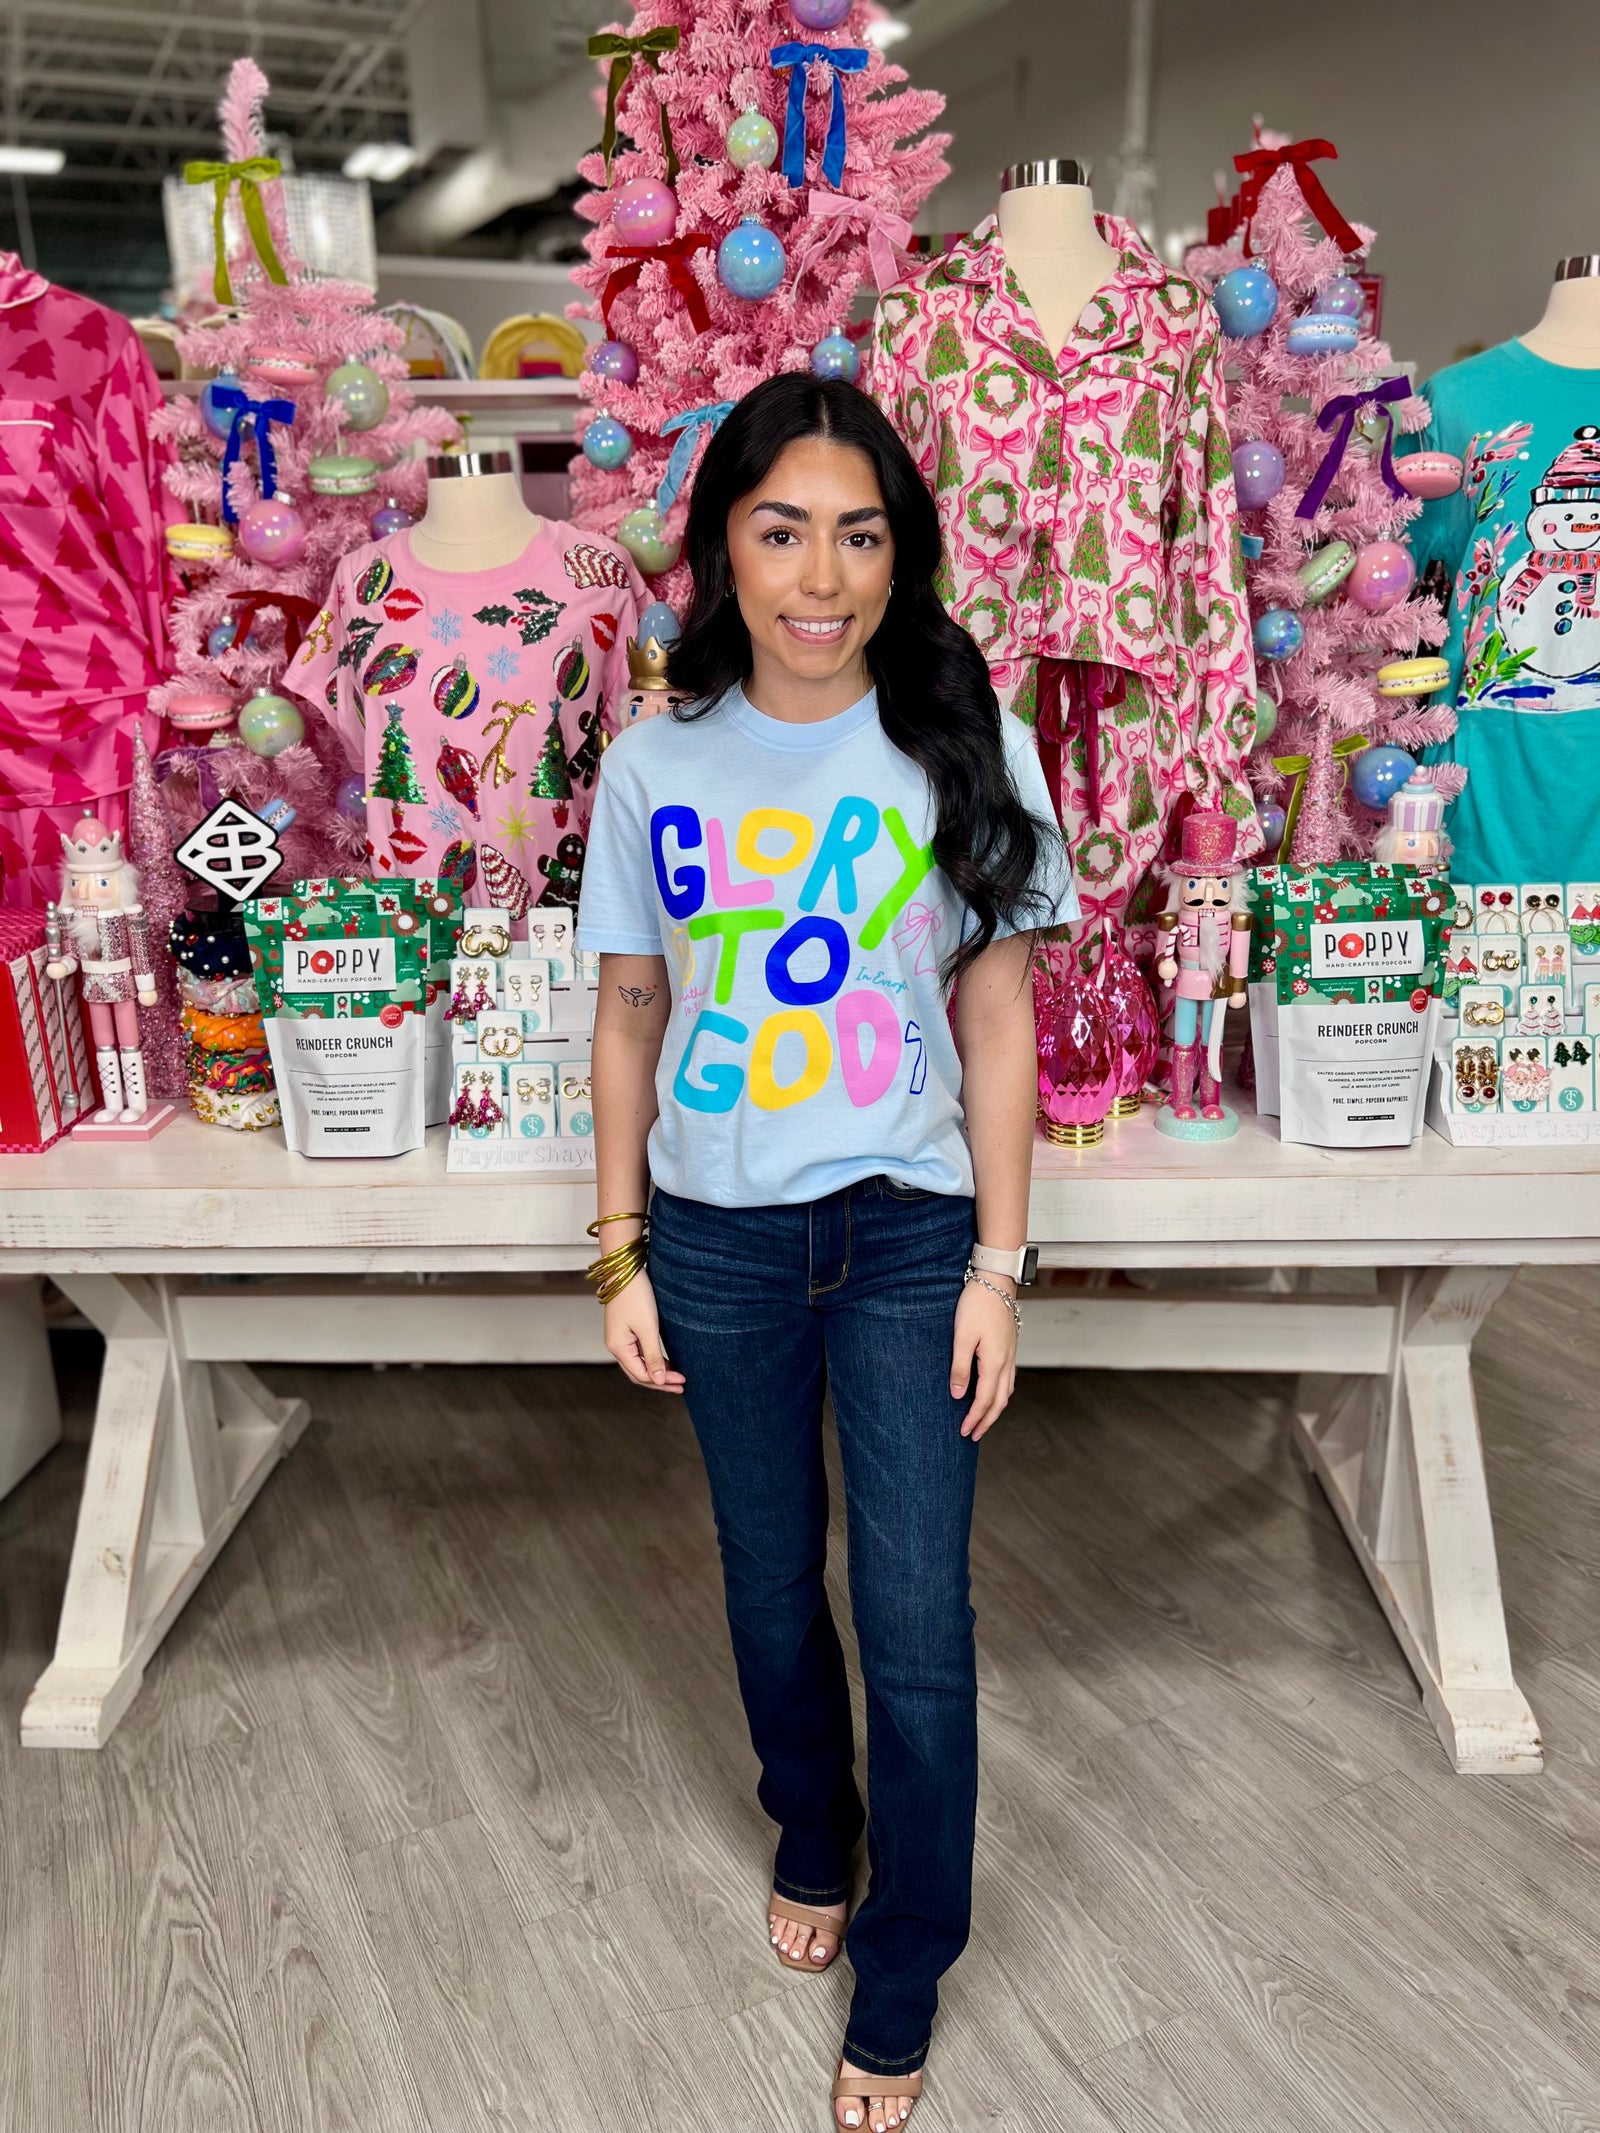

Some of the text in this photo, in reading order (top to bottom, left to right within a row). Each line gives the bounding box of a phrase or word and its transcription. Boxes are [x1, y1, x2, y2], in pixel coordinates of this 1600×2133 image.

[650, 796, 938, 950] GLORY
[688, 909, 850, 1005] TO
[1325, 931, 1409, 959] POPPY
[297, 948, 380, 975] POPPY
[1317, 1021, 1419, 1037] REINDEER CRUNCH
[295, 1036, 393, 1051] REINDEER CRUNCH
[673, 990, 901, 1114] GOD
[453, 1144, 594, 1170] Taylor Shay
